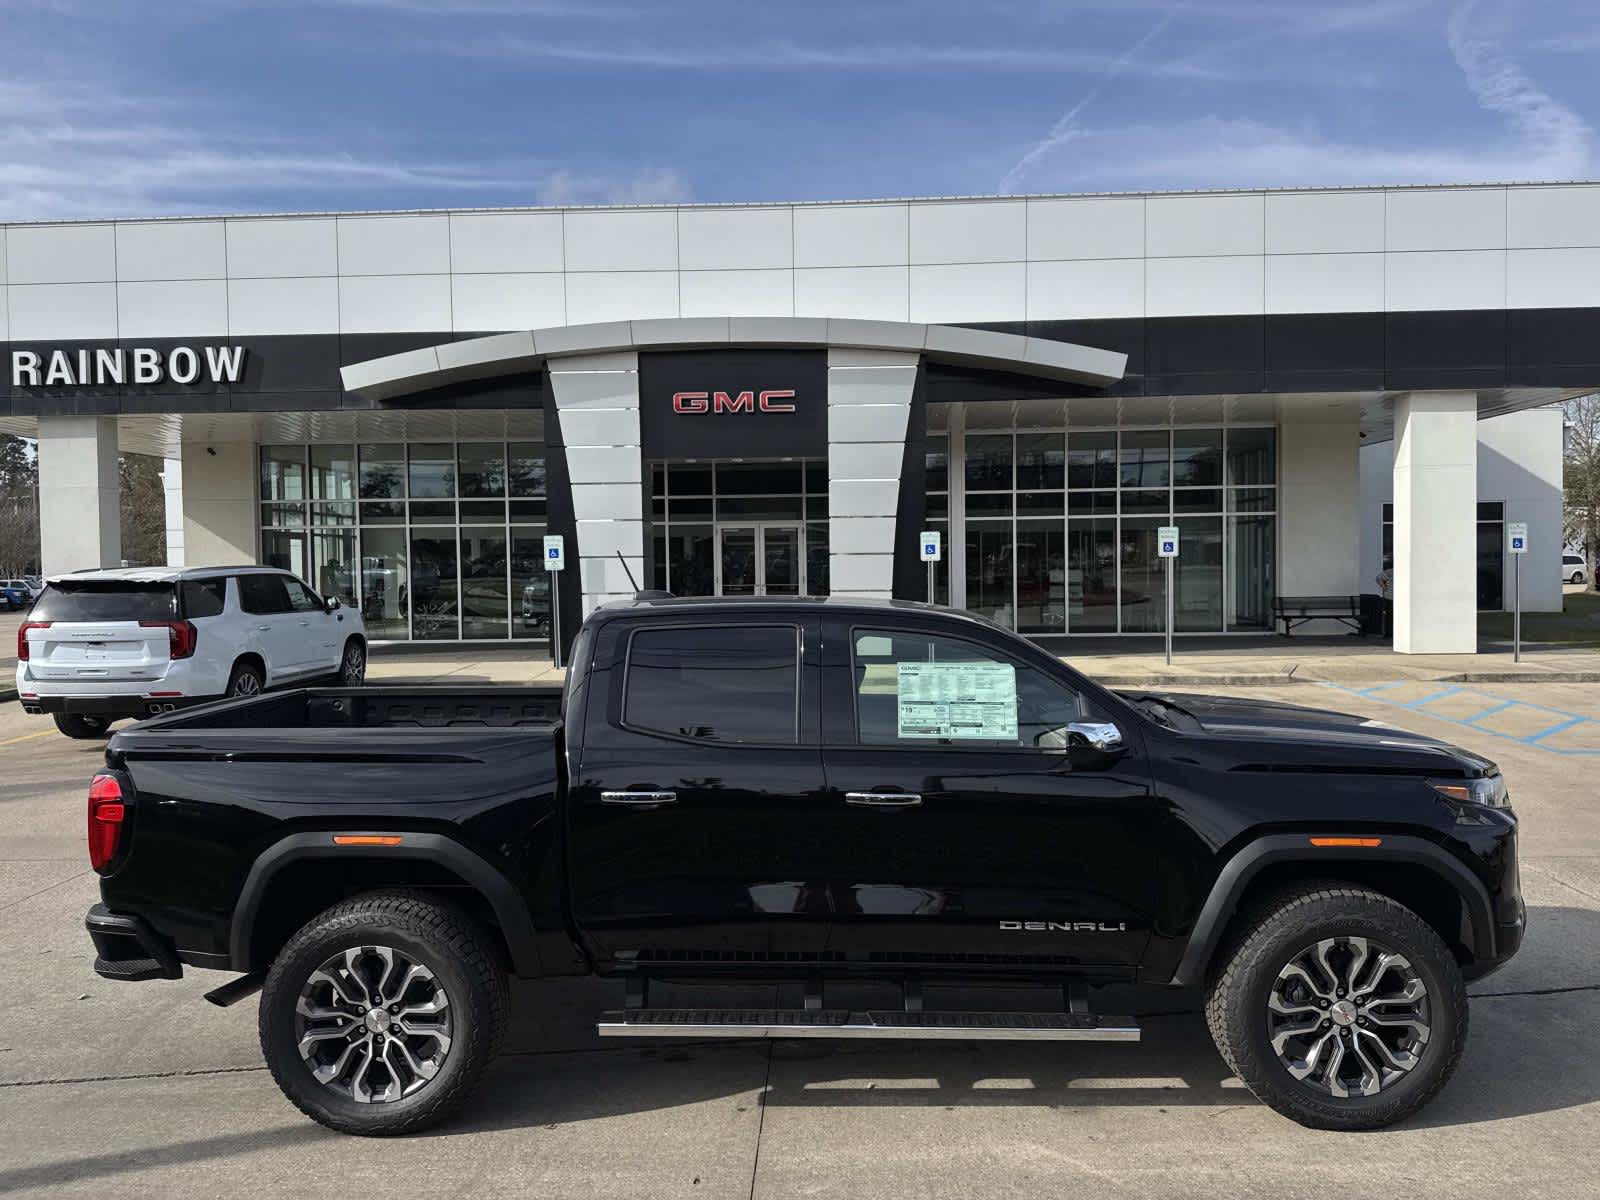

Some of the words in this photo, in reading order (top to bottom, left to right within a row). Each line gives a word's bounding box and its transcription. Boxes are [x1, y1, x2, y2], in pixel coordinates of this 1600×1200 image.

[12, 346, 244, 386] RAINBOW
[673, 390, 796, 413] GMC
[999, 920, 1126, 931] DENALI
